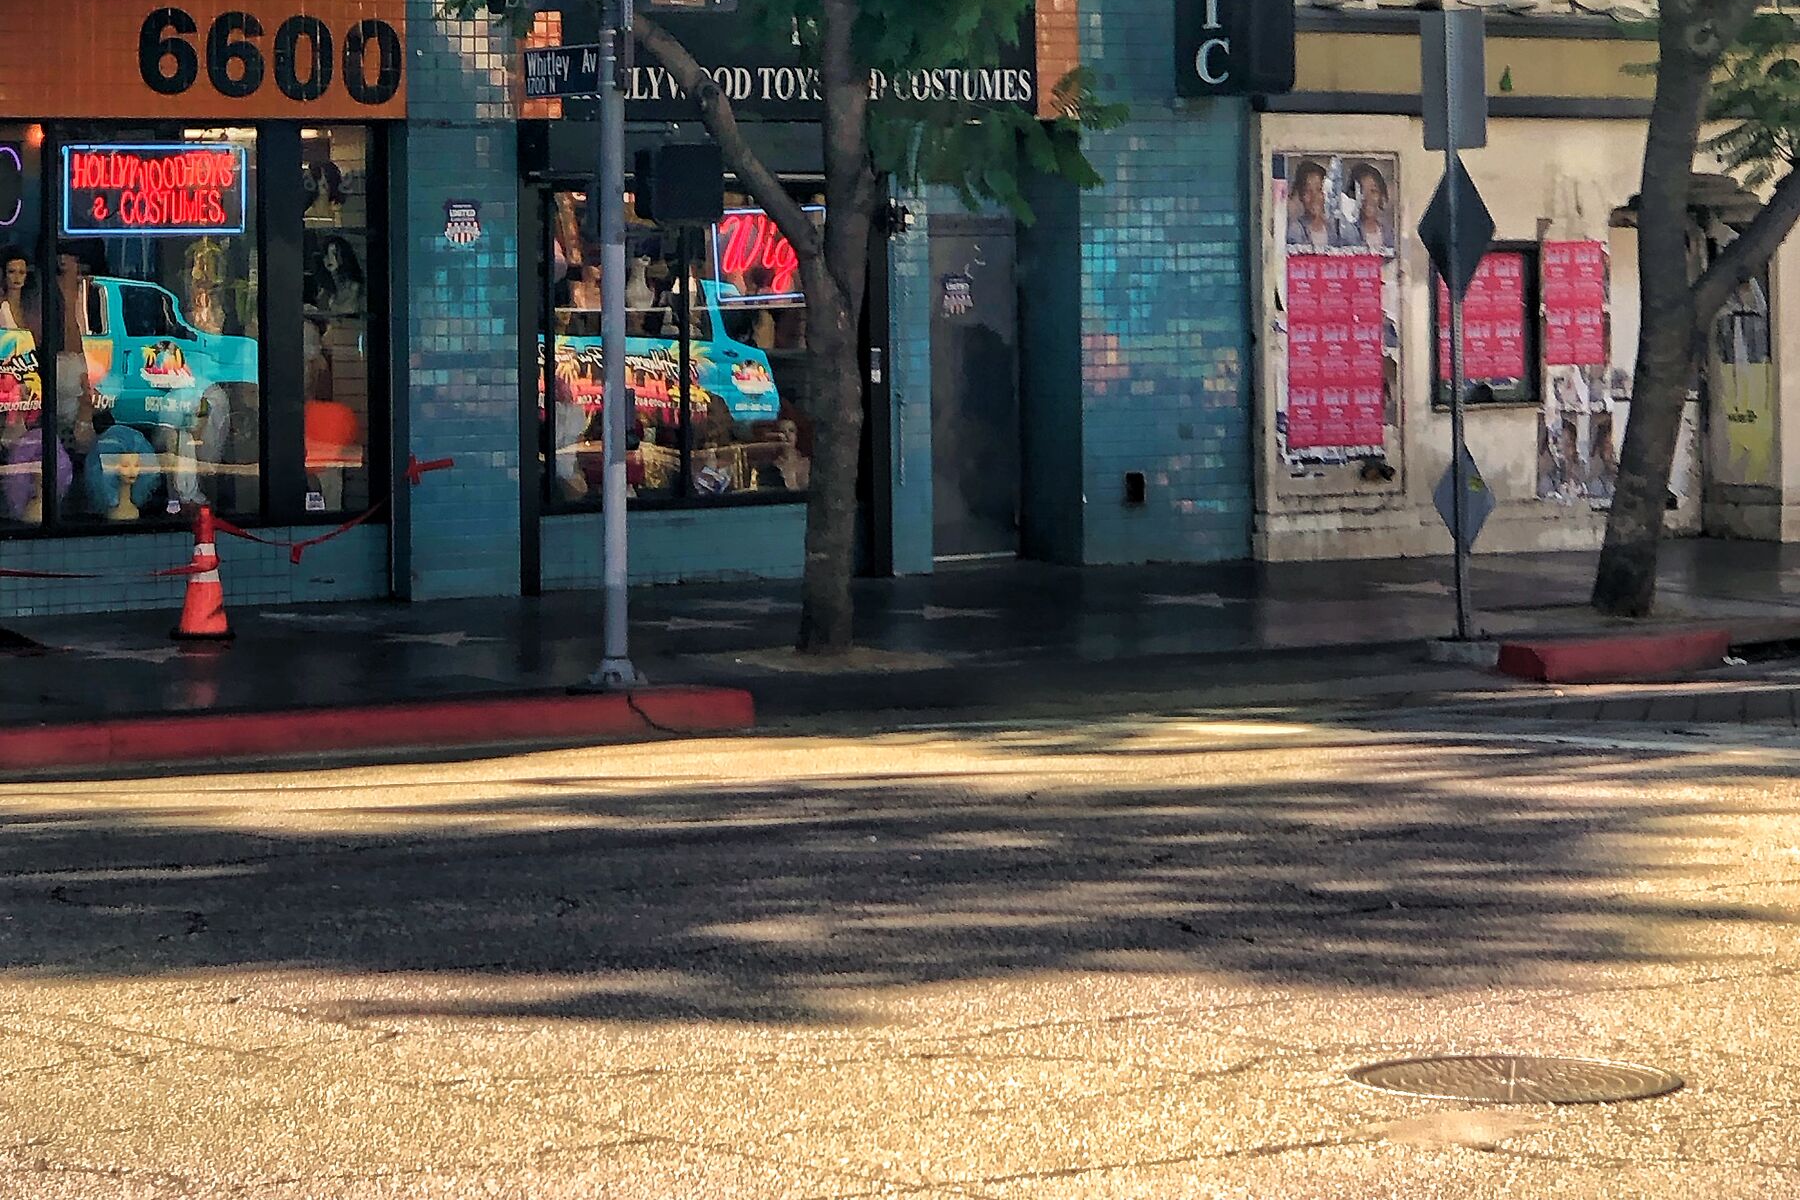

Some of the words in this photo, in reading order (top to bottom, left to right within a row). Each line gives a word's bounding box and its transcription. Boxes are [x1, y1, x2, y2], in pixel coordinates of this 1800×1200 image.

[138, 7, 402, 105] 6600
[527, 52, 570, 81] Whitley
[582, 49, 597, 73] Av
[549, 76, 556, 93] N
[893, 67, 1033, 101] COSTUMES
[73, 153, 188, 191] HOLLYWOOD
[186, 152, 236, 187] TOYS
